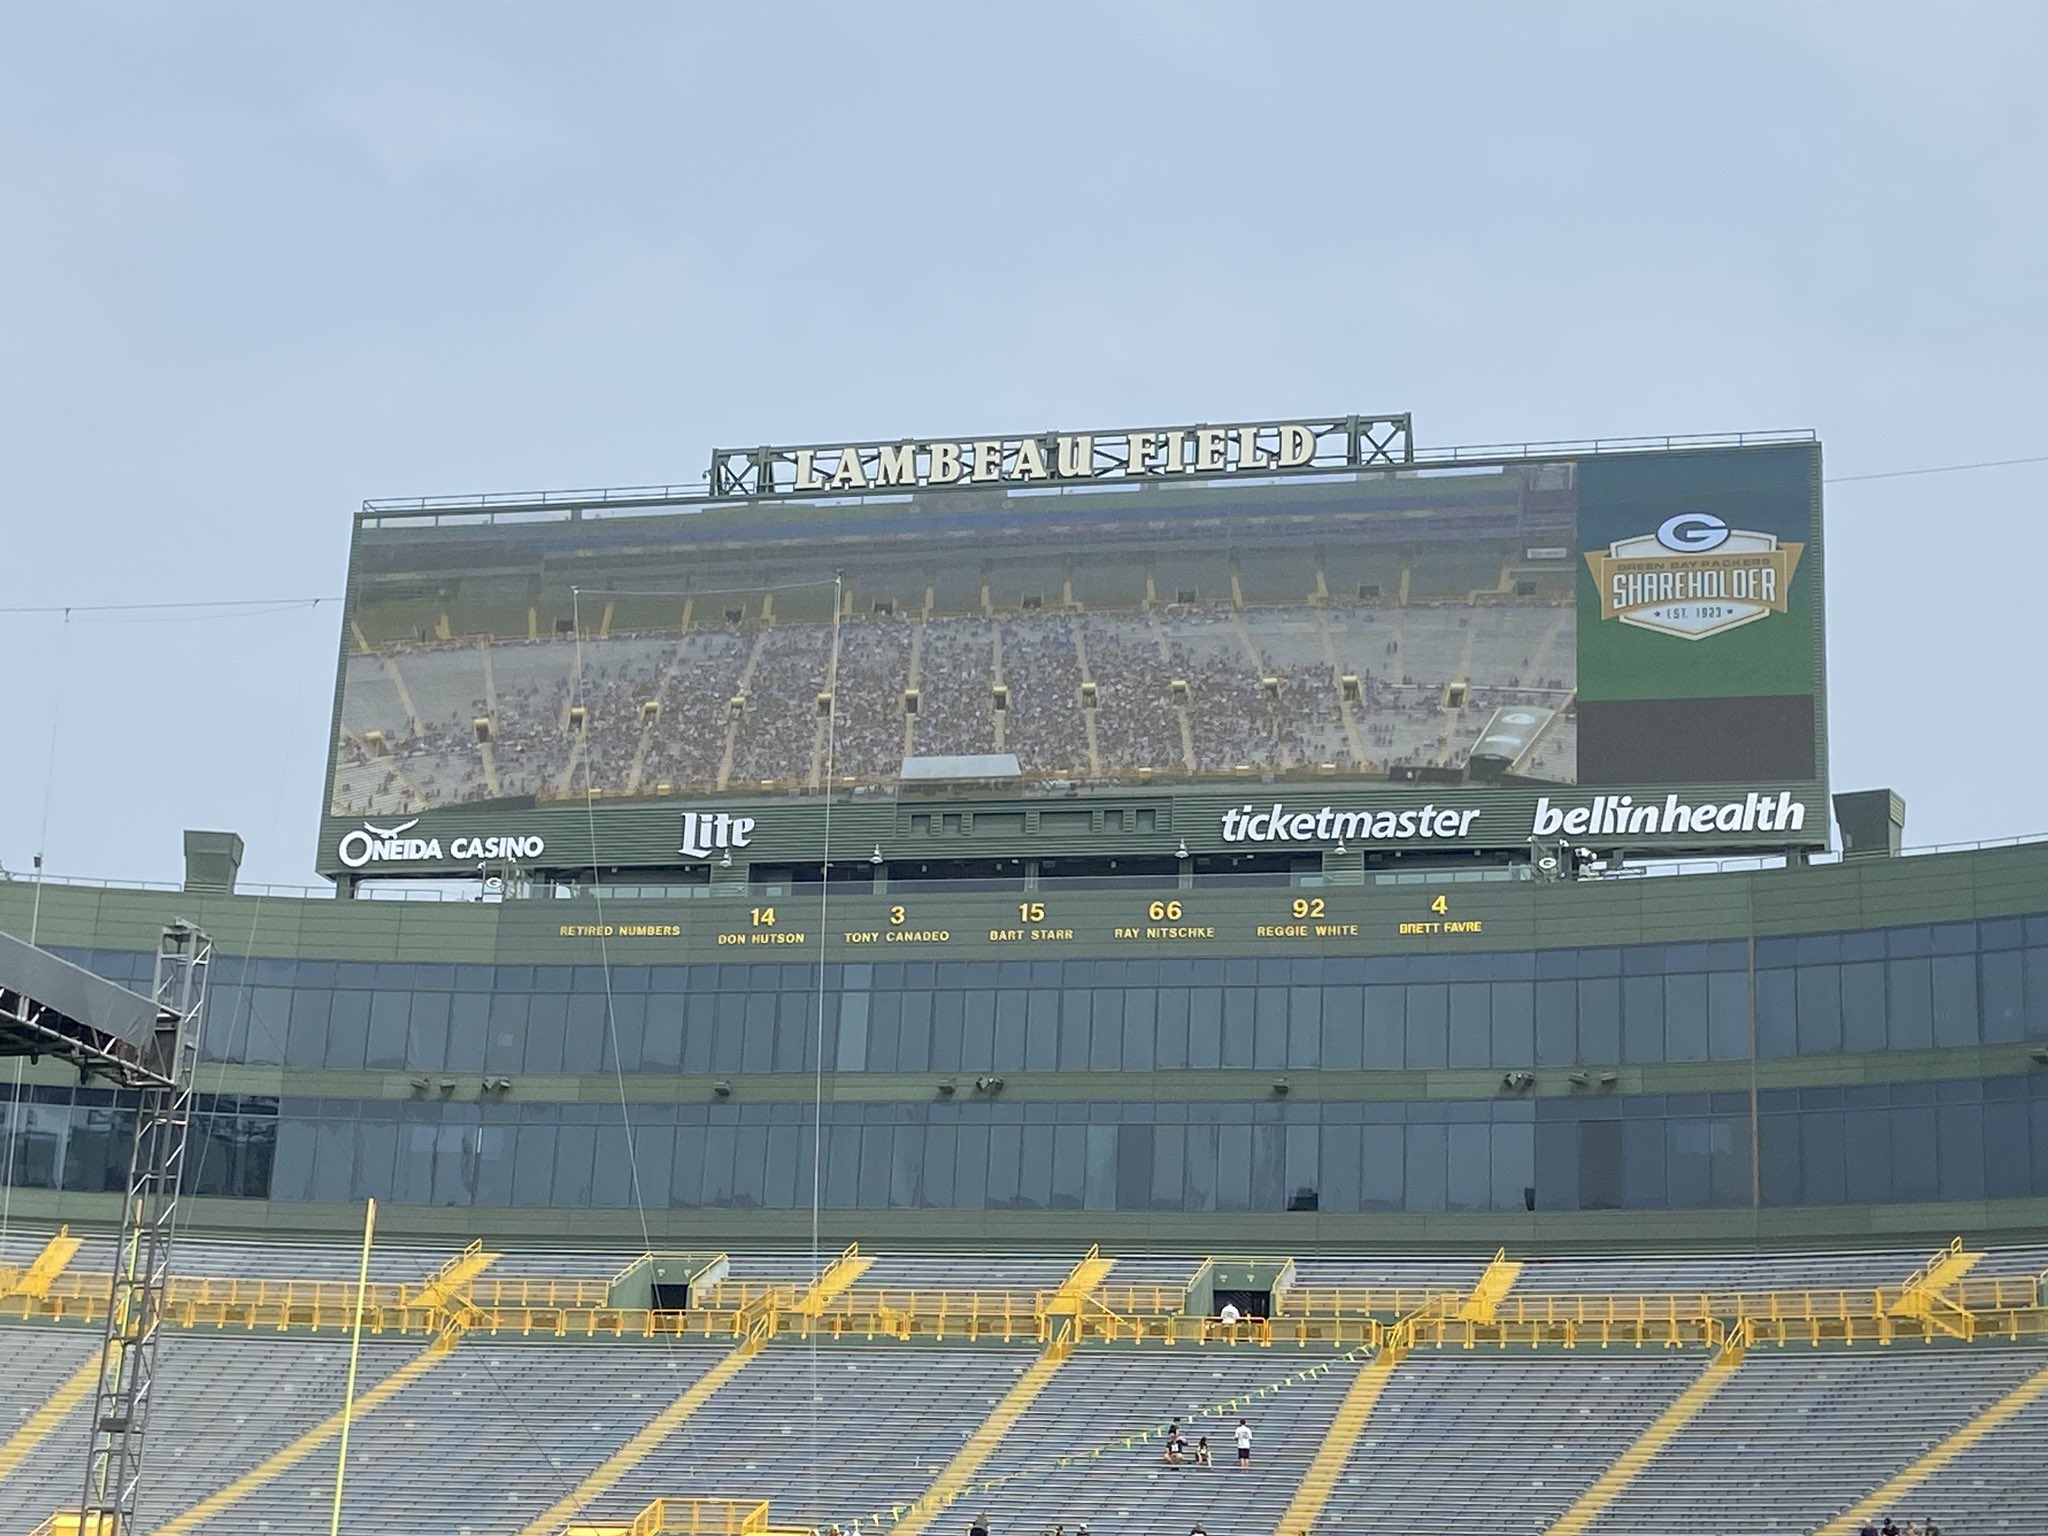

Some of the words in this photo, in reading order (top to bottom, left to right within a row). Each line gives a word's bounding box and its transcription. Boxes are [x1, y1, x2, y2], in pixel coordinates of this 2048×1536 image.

[795, 434, 1092, 490] LAMBEAU
[1126, 425, 1316, 473] FIELD
[1657, 512, 1730, 552] G
[1617, 561, 1665, 571] GREEN
[1670, 560, 1699, 570] BAY
[1700, 557, 1771, 568] PACKERS
[1613, 567, 1776, 609] SHAREHOLDER
[1667, 608, 1689, 619] EST.
[1696, 606, 1722, 618] 1923
[1221, 803, 1480, 842] ticketmaster
[1532, 791, 1805, 835] bellinhealth
[678, 812, 755, 858] Lite
[339, 831, 443, 867] ONEIDA
[450, 836, 545, 859] CASINO
[890, 905, 905, 924] 3
[1019, 903, 1045, 922] 15
[1148, 901, 1182, 920] 66
[1292, 898, 1325, 918] 92
[1431, 895, 1448, 915] 4
[750, 907, 776, 927] 14
[560, 925, 613, 936] RETIRED
[619, 925, 681, 936] NUMBERS
[844, 931, 879, 943] TONY
[886, 931, 949, 942] CANADEO
[989, 930, 1024, 940] BART
[1031, 929, 1073, 940] STARR
[1114, 928, 1140, 939] RAY
[1146, 926, 1215, 938] NITSCHKE
[1257, 926, 1308, 937] REGGIE
[1315, 925, 1358, 936] WHITE
[1399, 922, 1439, 934] BRETT
[1444, 921, 1482, 933] FAVRE
[718, 934, 746, 945] DON
[751, 933, 804, 944] HUTSON
